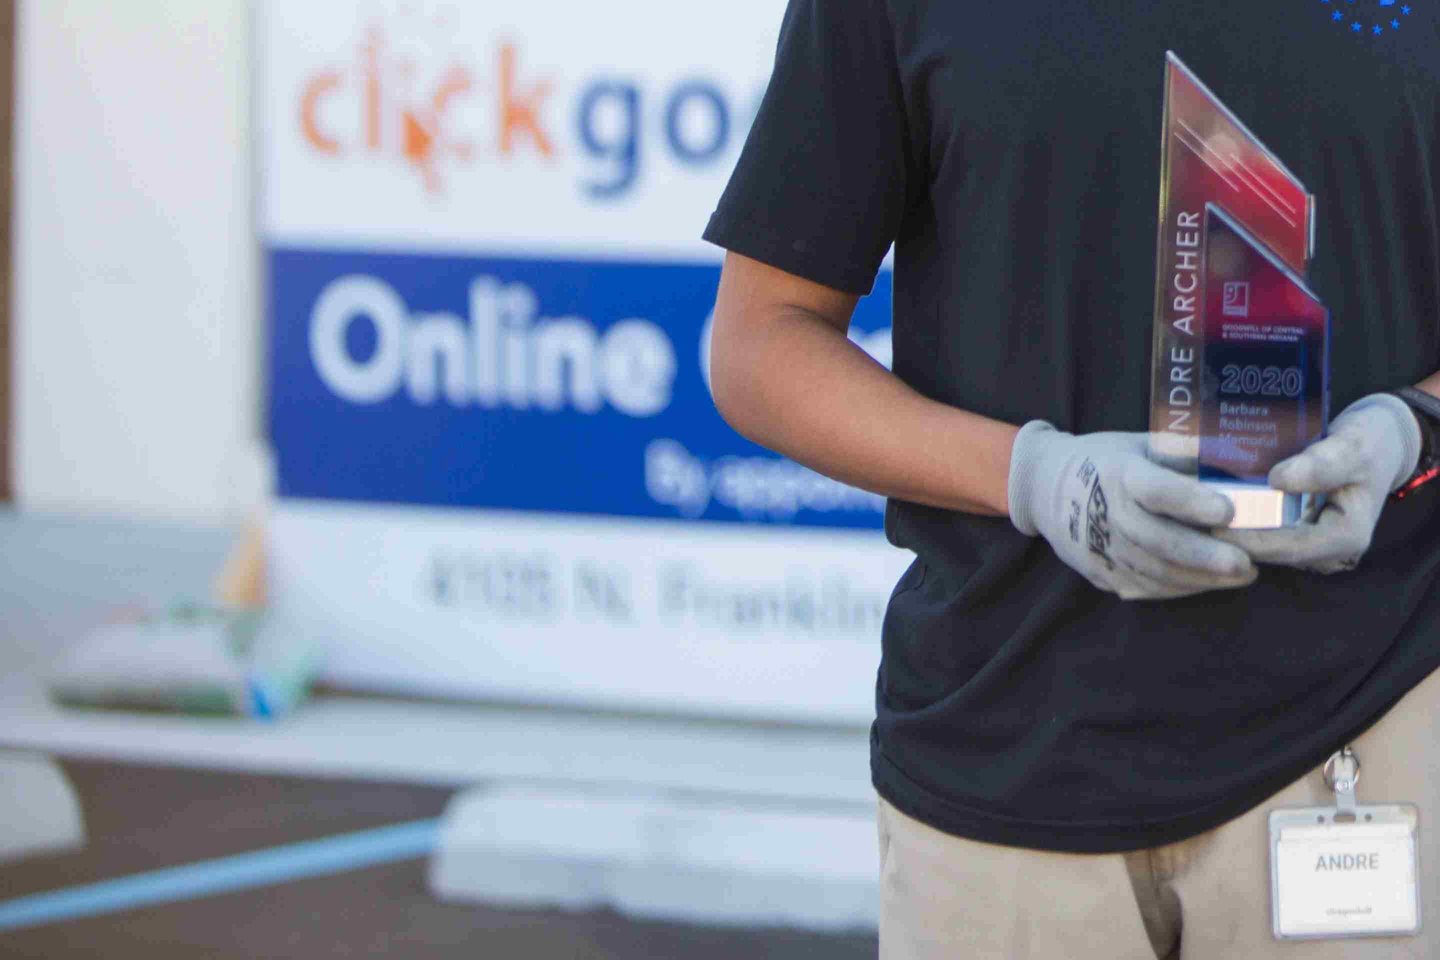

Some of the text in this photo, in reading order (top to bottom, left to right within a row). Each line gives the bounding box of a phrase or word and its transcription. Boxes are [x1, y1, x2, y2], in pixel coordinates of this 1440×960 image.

[298, 24, 764, 200] clickgo
[1173, 211, 1199, 336] ARCHER
[308, 273, 678, 418] Online
[1220, 364, 1302, 397] 2020
[1220, 401, 1269, 417] Barbara
[1220, 416, 1277, 433] Robinson
[1315, 852, 1380, 873] ANDRE
